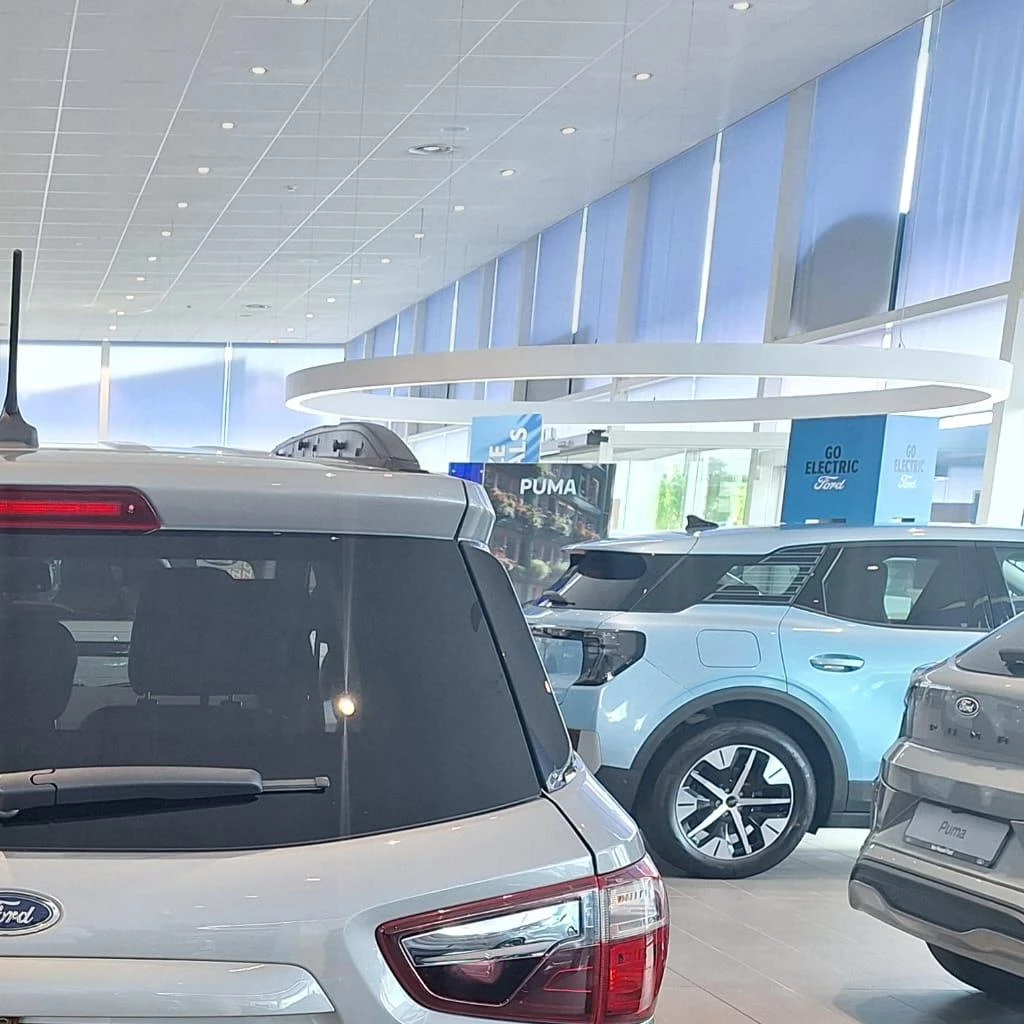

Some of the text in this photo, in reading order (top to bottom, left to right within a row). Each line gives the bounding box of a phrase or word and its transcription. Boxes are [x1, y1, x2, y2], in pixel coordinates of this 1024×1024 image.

[825, 445, 842, 460] GO
[906, 444, 917, 458] GO
[805, 459, 860, 475] ELECTRIC
[894, 458, 925, 473] ELECTRIC
[519, 478, 577, 495] PUMA
[813, 475, 846, 491] Ford
[938, 820, 967, 840] Puma
